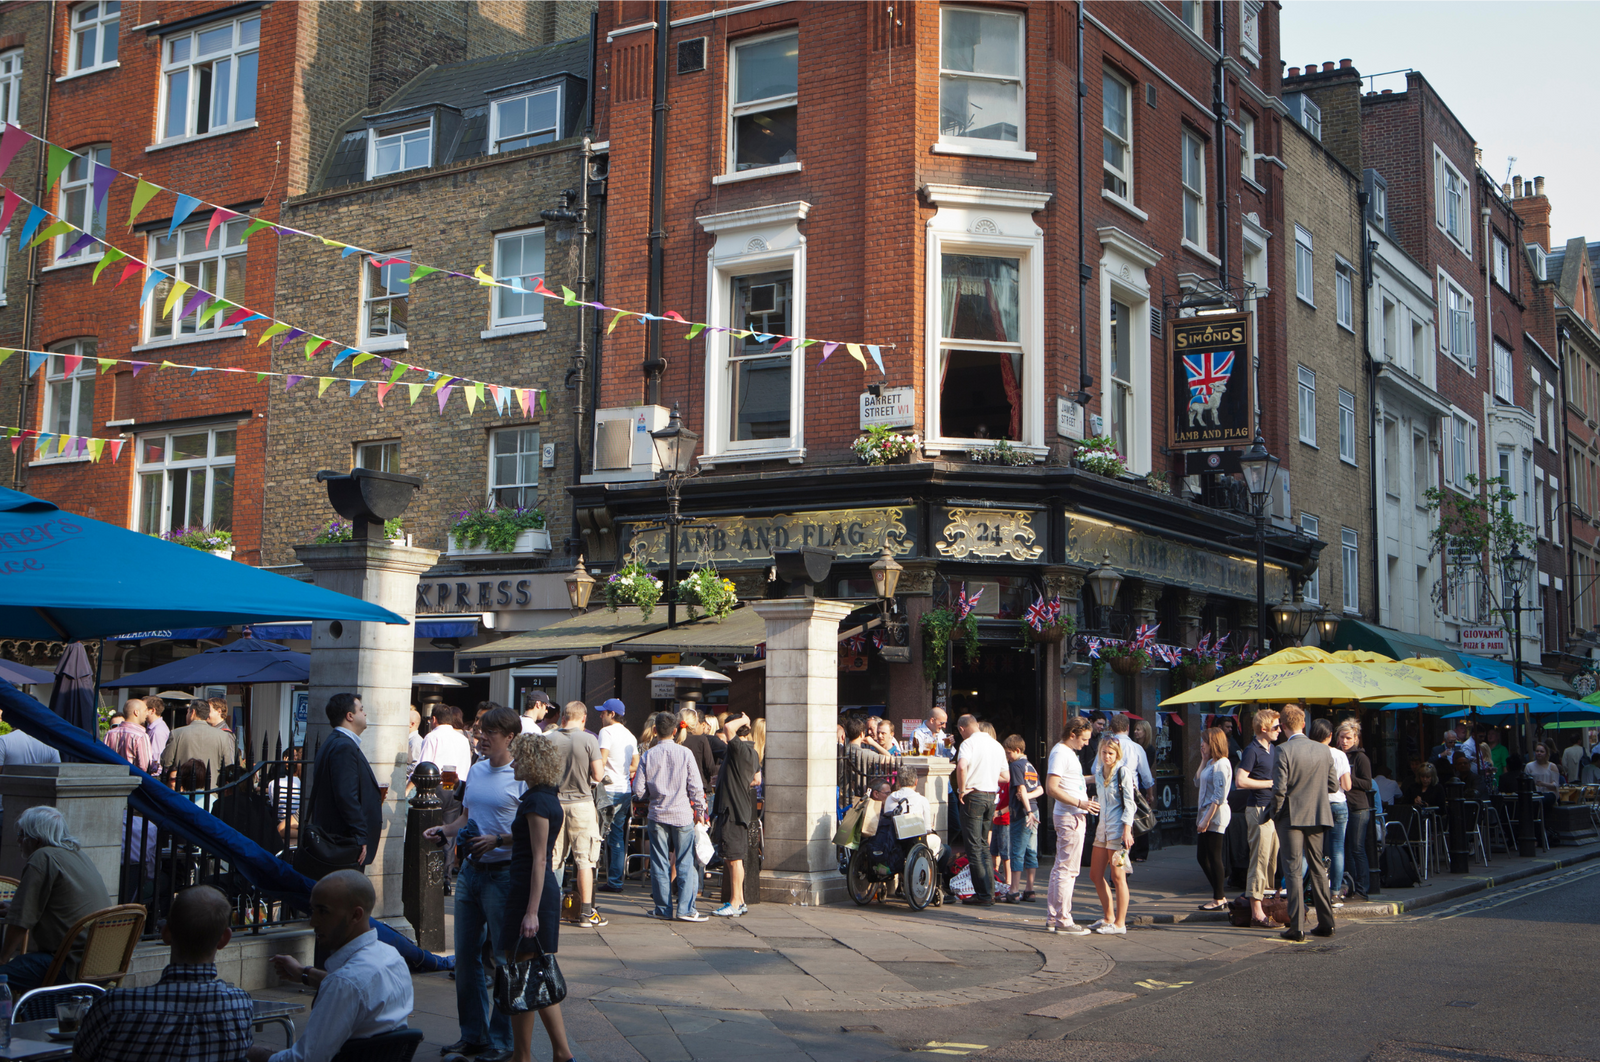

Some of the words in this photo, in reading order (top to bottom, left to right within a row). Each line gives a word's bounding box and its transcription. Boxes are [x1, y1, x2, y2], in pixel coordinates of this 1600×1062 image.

[1177, 326, 1242, 348] SIMONDS
[864, 394, 901, 406] BARRETT
[864, 406, 894, 418] STREET
[898, 404, 909, 414] W1
[1061, 403, 1076, 416] JAMES
[1060, 414, 1076, 428] STREET
[1174, 430, 1199, 441] LAMB
[1202, 428, 1222, 439] AND
[1224, 427, 1248, 438] FLAG
[664, 528, 727, 555] LAMB
[740, 526, 790, 550] AND
[802, 522, 865, 548] FLAG
[977, 522, 1003, 547] 24
[1463, 630, 1504, 639] GIOVANNI
[1463, 642, 1478, 650] PIZZA
[1480, 642, 1485, 650] &
[1487, 642, 1504, 650] PASTA
[1240, 680, 1282, 696] Place
